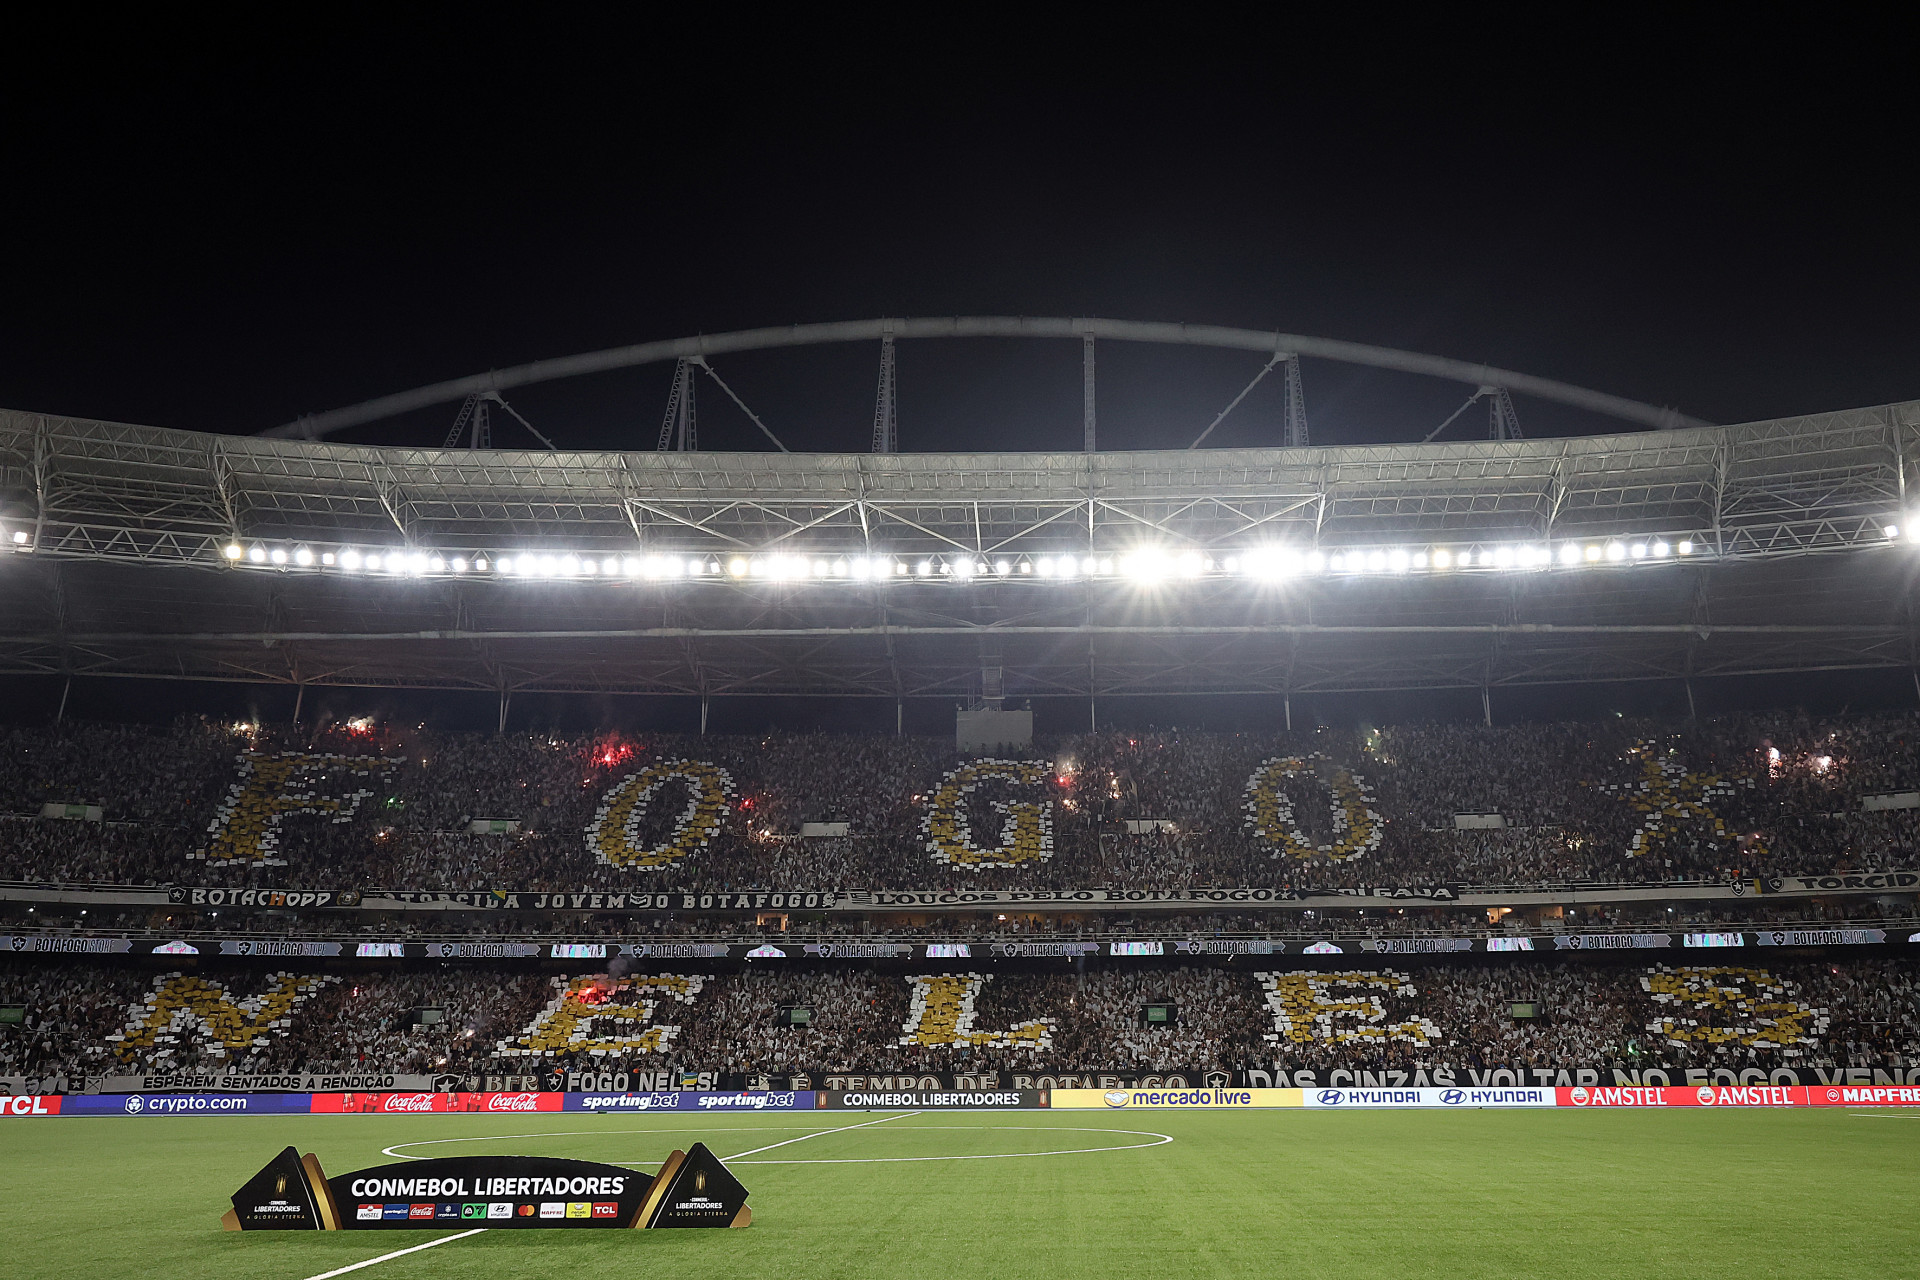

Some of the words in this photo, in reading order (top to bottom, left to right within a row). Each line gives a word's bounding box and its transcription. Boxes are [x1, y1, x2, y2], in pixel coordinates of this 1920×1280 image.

[191, 889, 331, 907] BOTACHOPP
[534, 894, 626, 909] JOVEM
[683, 893, 819, 909] BOTAFOGO
[874, 893, 998, 905] LOUCOS
[1009, 891, 1094, 901] PELO
[1106, 889, 1273, 900] BOTAFOGO
[34, 938, 88, 952] BOTAFOGO
[1588, 936, 1632, 949] BOTAFOGO
[1793, 931, 1842, 945] BOTAFOGO
[256, 942, 303, 956] BOTAFOGO
[459, 944, 503, 957] BOTAFOGO
[650, 945, 694, 958] BOTAFOGO
[834, 945, 877, 957] BOTAFOGO
[1021, 944, 1063, 956] BOTAFOGO
[1207, 942, 1249, 955] BOTAFOGO
[1392, 939, 1436, 953] BOTAFOGO
[143, 1076, 216, 1089] ESPEREM
[221, 1076, 301, 1089] SENTADOS
[305, 1077, 315, 1089] A
[485, 1075, 538, 1092] BFR
[567, 1072, 629, 1092] FOGO
[825, 1075, 942, 1090] TEMPO
[954, 1074, 999, 1089] DE
[1249, 1069, 1317, 1088] DAS
[1330, 1068, 1456, 1088] CINZAS
[1612, 1068, 1670, 1087] NO
[1685, 1067, 1800, 1087] FOGO
[488, 1093, 540, 1111] Coca-Cola
[582, 1092, 680, 1110] sportingbet
[698, 1092, 795, 1109] sportingbet
[843, 1093, 920, 1106] CONMEBOL
[922, 1093, 1020, 1105] LIBERTADORES
[1133, 1089, 1211, 1105] mercado
[1214, 1089, 1251, 1105] livre
[1350, 1092, 1420, 1103] HYUNDAI
[1471, 1091, 1542, 1103] HYUNDAI
[1591, 1087, 1668, 1106] AMSTEL
[1718, 1086, 1794, 1105] AMSTEL
[1843, 1088, 1920, 1102] MAPFRE
[0, 1096, 48, 1115] TCL
[149, 1096, 247, 1112] crypto.com
[384, 1094, 436, 1112] Coca-Cola
[351, 1178, 469, 1197] CONMEBOL
[474, 1176, 624, 1196] LIBERTADORES
[254, 1205, 301, 1213] LIBERTADORES
[595, 1206, 616, 1215] TCL
